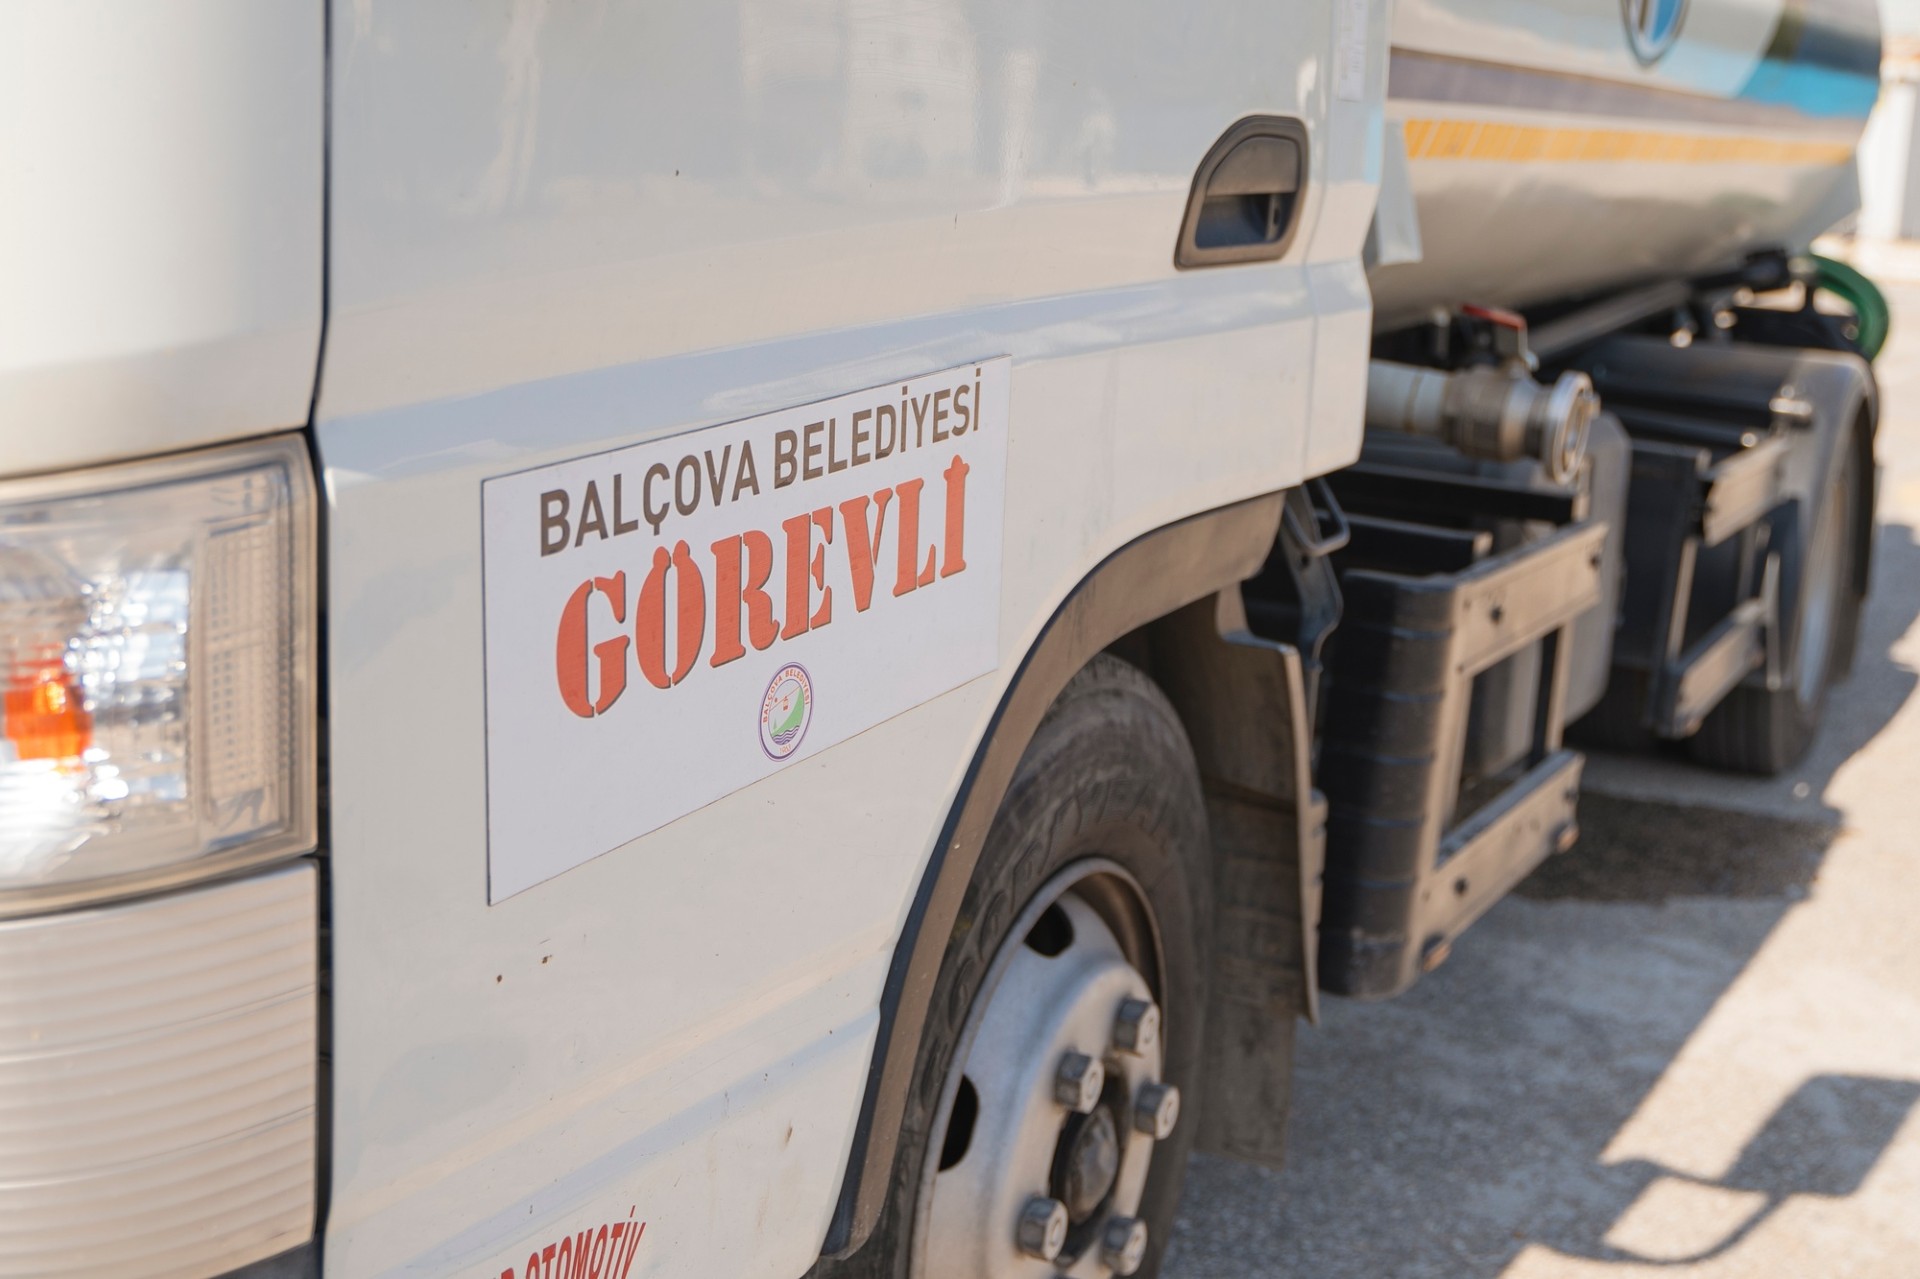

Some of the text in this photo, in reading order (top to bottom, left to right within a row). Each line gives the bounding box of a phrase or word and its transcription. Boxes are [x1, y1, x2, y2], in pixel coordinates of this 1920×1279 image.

[540, 367, 982, 557] BALÇOVA BELEDİYESİ
[556, 454, 970, 718] GÖREVLİ
